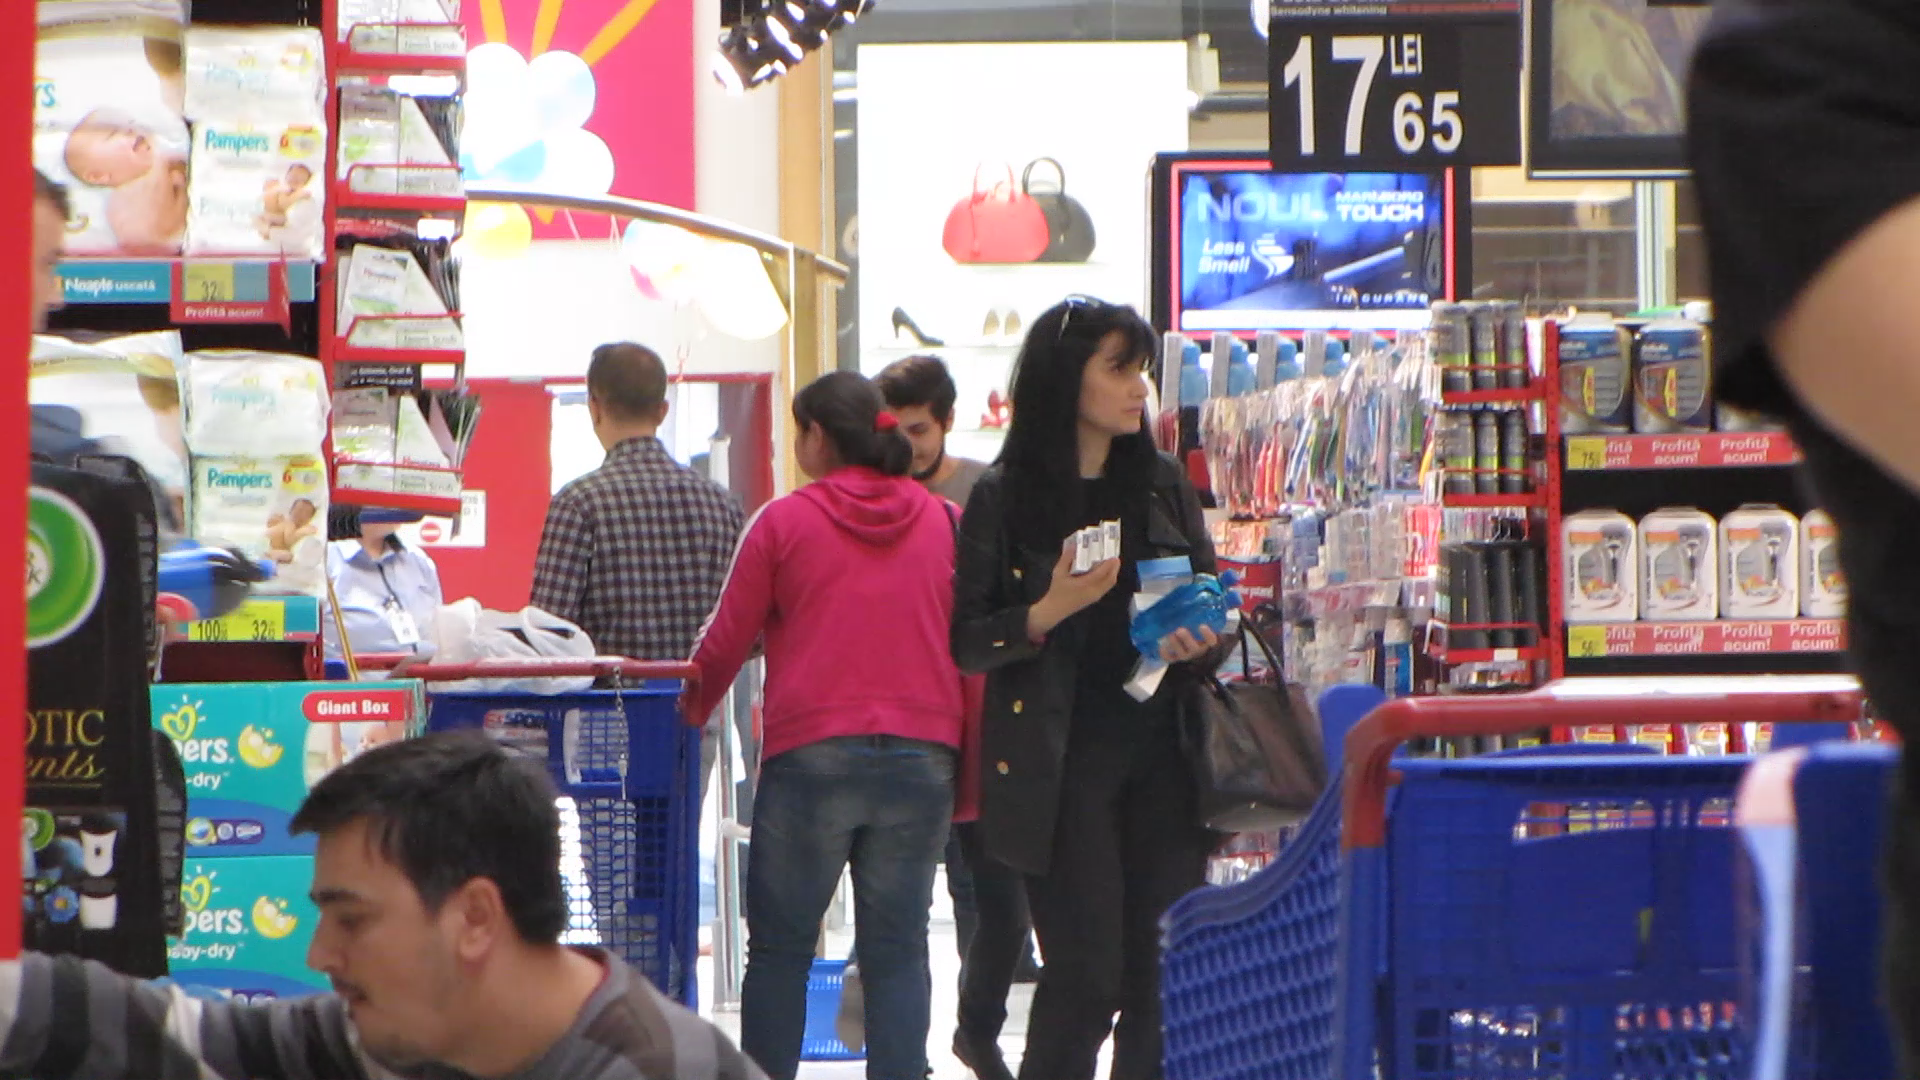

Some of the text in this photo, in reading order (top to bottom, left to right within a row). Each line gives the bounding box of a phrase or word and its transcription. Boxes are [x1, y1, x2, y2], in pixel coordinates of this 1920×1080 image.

[1390, 34, 1423, 74] LEI
[1284, 34, 1385, 156] 17
[1393, 91, 1463, 154] 65
[206, 129, 270, 157] Pampers
[1335, 190, 1424, 203] MARLBORO
[1198, 192, 1330, 222] NOUL
[1336, 204, 1424, 223] TOUCH
[1202, 238, 1246, 256] Less
[1198, 256, 1250, 274] Smell
[1654, 452, 1699, 466] acum!
[1723, 450, 1768, 464] acum!
[207, 467, 273, 494] Pampers
[198, 620, 221, 641] 100
[1655, 638, 1702, 653] acum!
[1724, 637, 1771, 652] acum!
[1791, 636, 1840, 651] acum!
[317, 699, 391, 715] Giant Box
